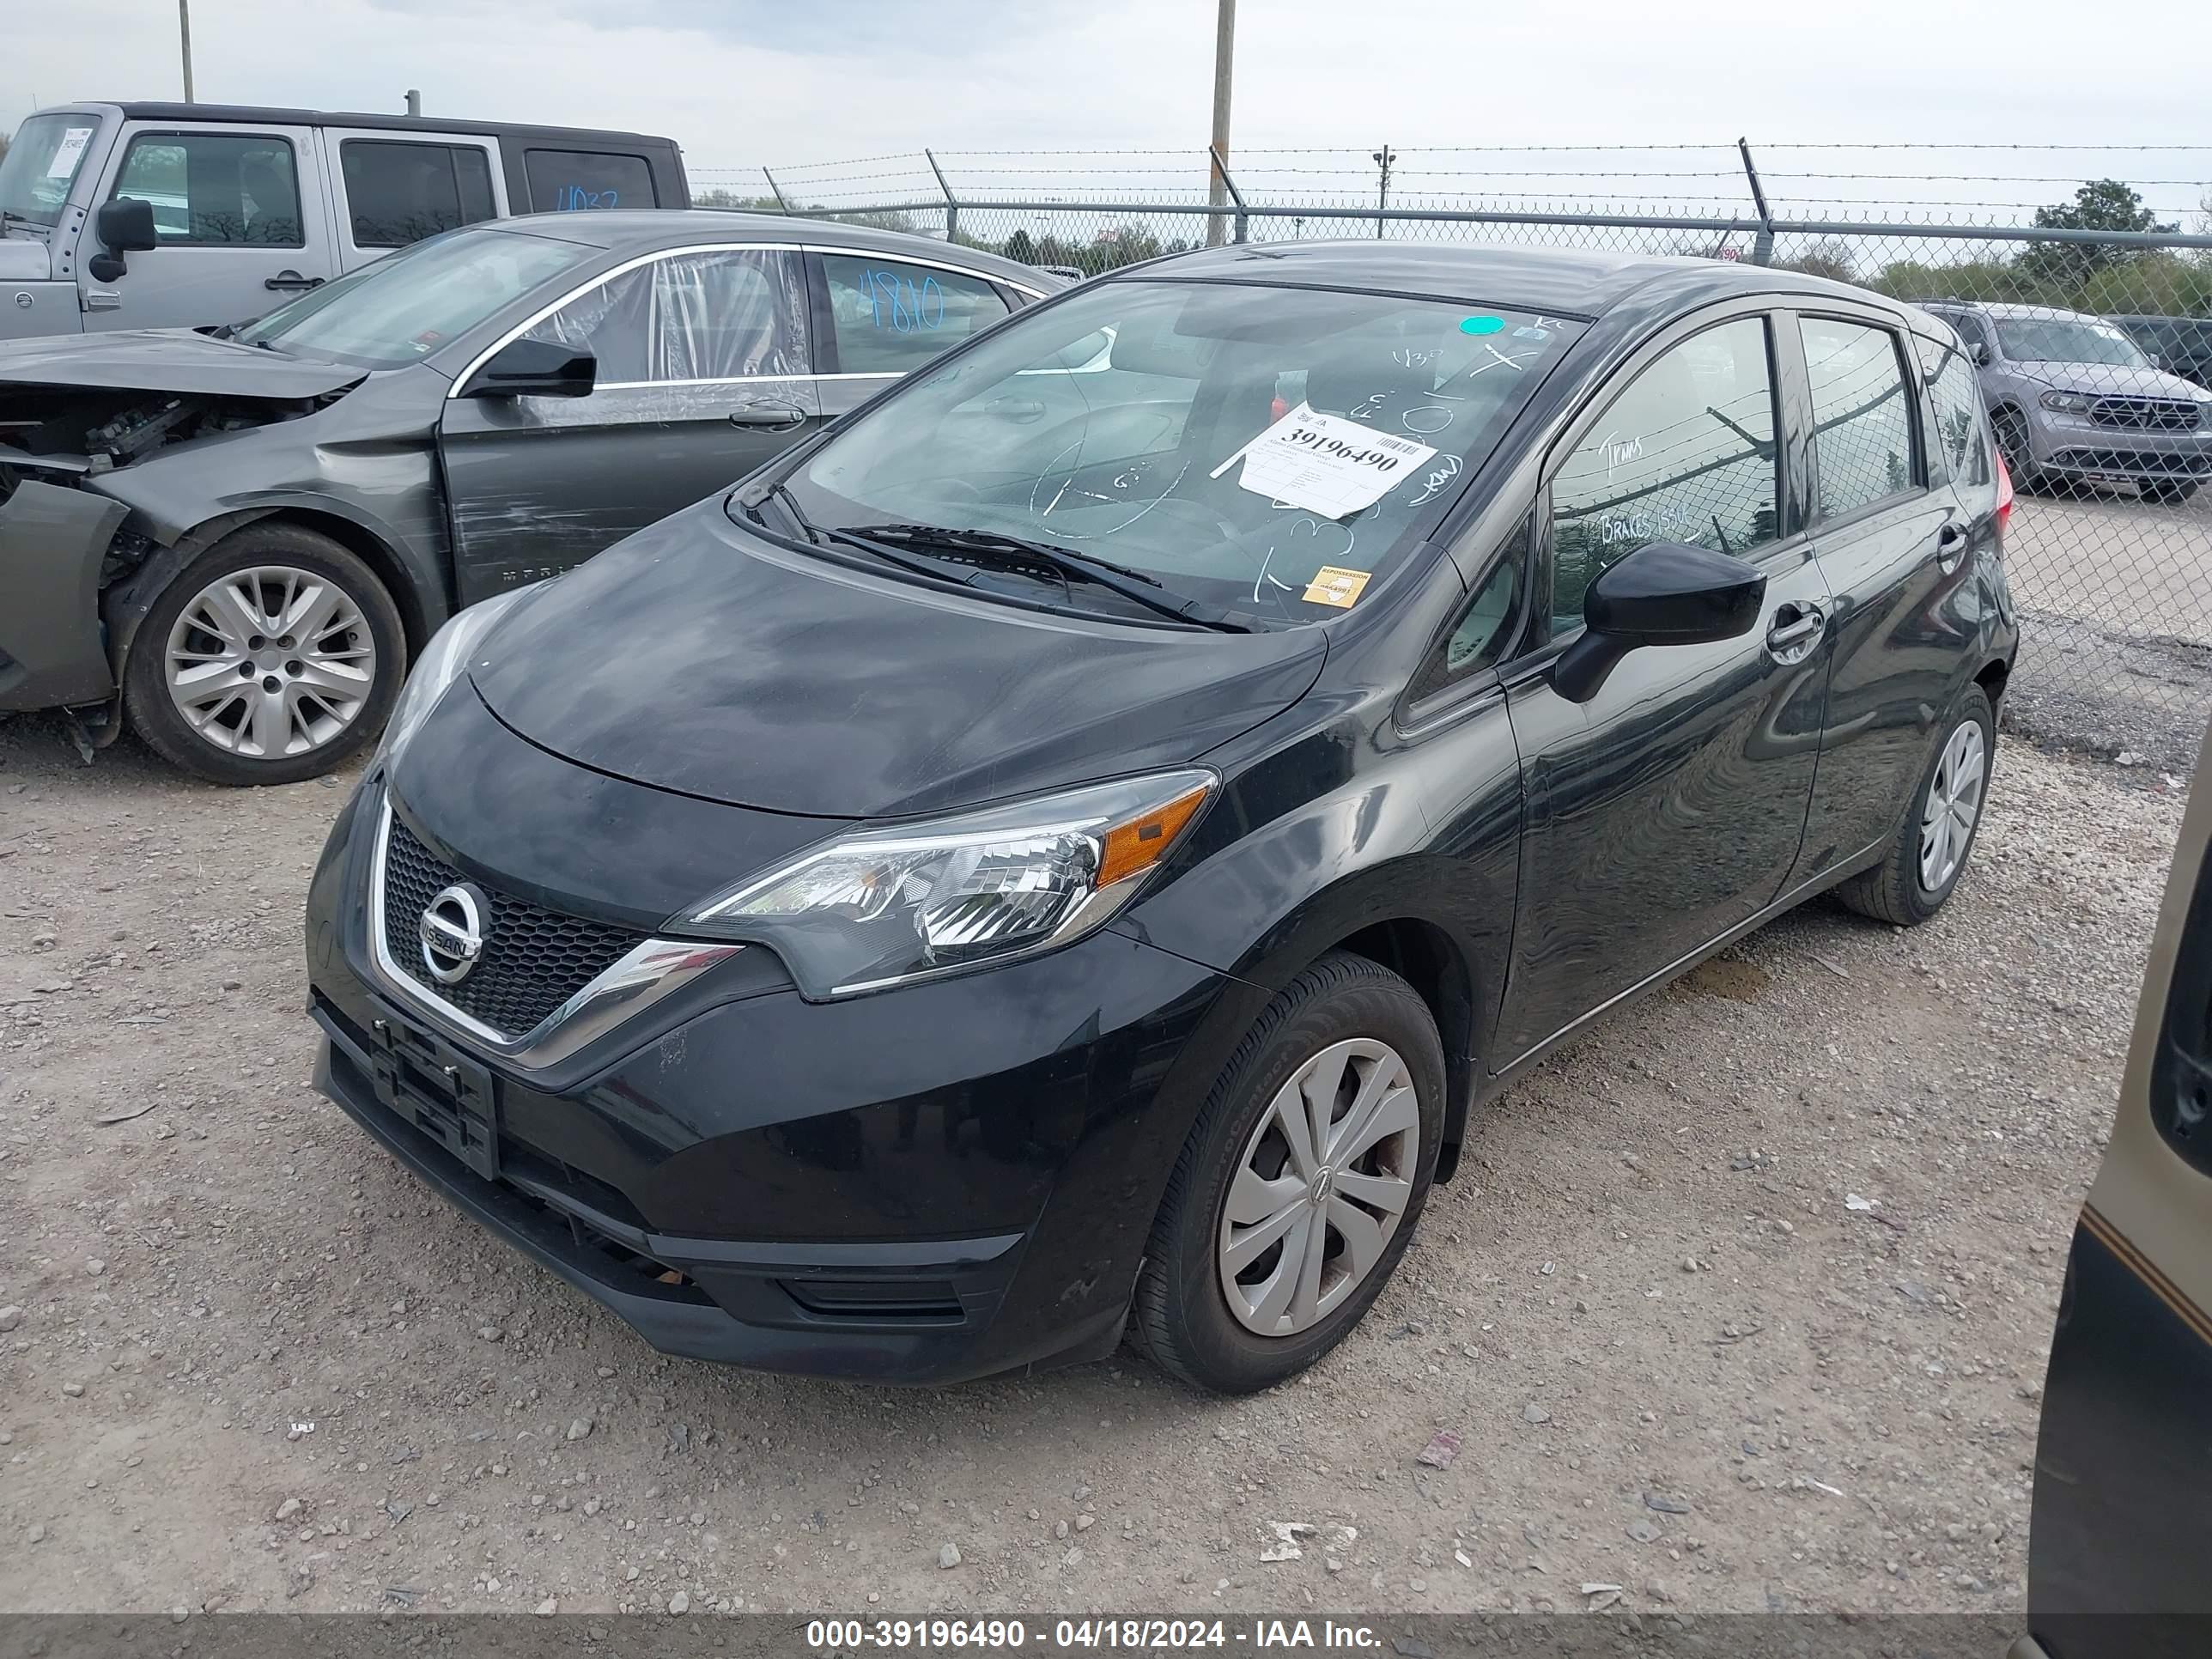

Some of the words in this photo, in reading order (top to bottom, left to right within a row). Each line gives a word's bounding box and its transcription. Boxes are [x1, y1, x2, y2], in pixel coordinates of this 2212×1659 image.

[1281, 428, 1399, 471] 39196490
[1322, 568, 1369, 580] REPOSSESSION
[422, 921, 467, 956] NISSAN
